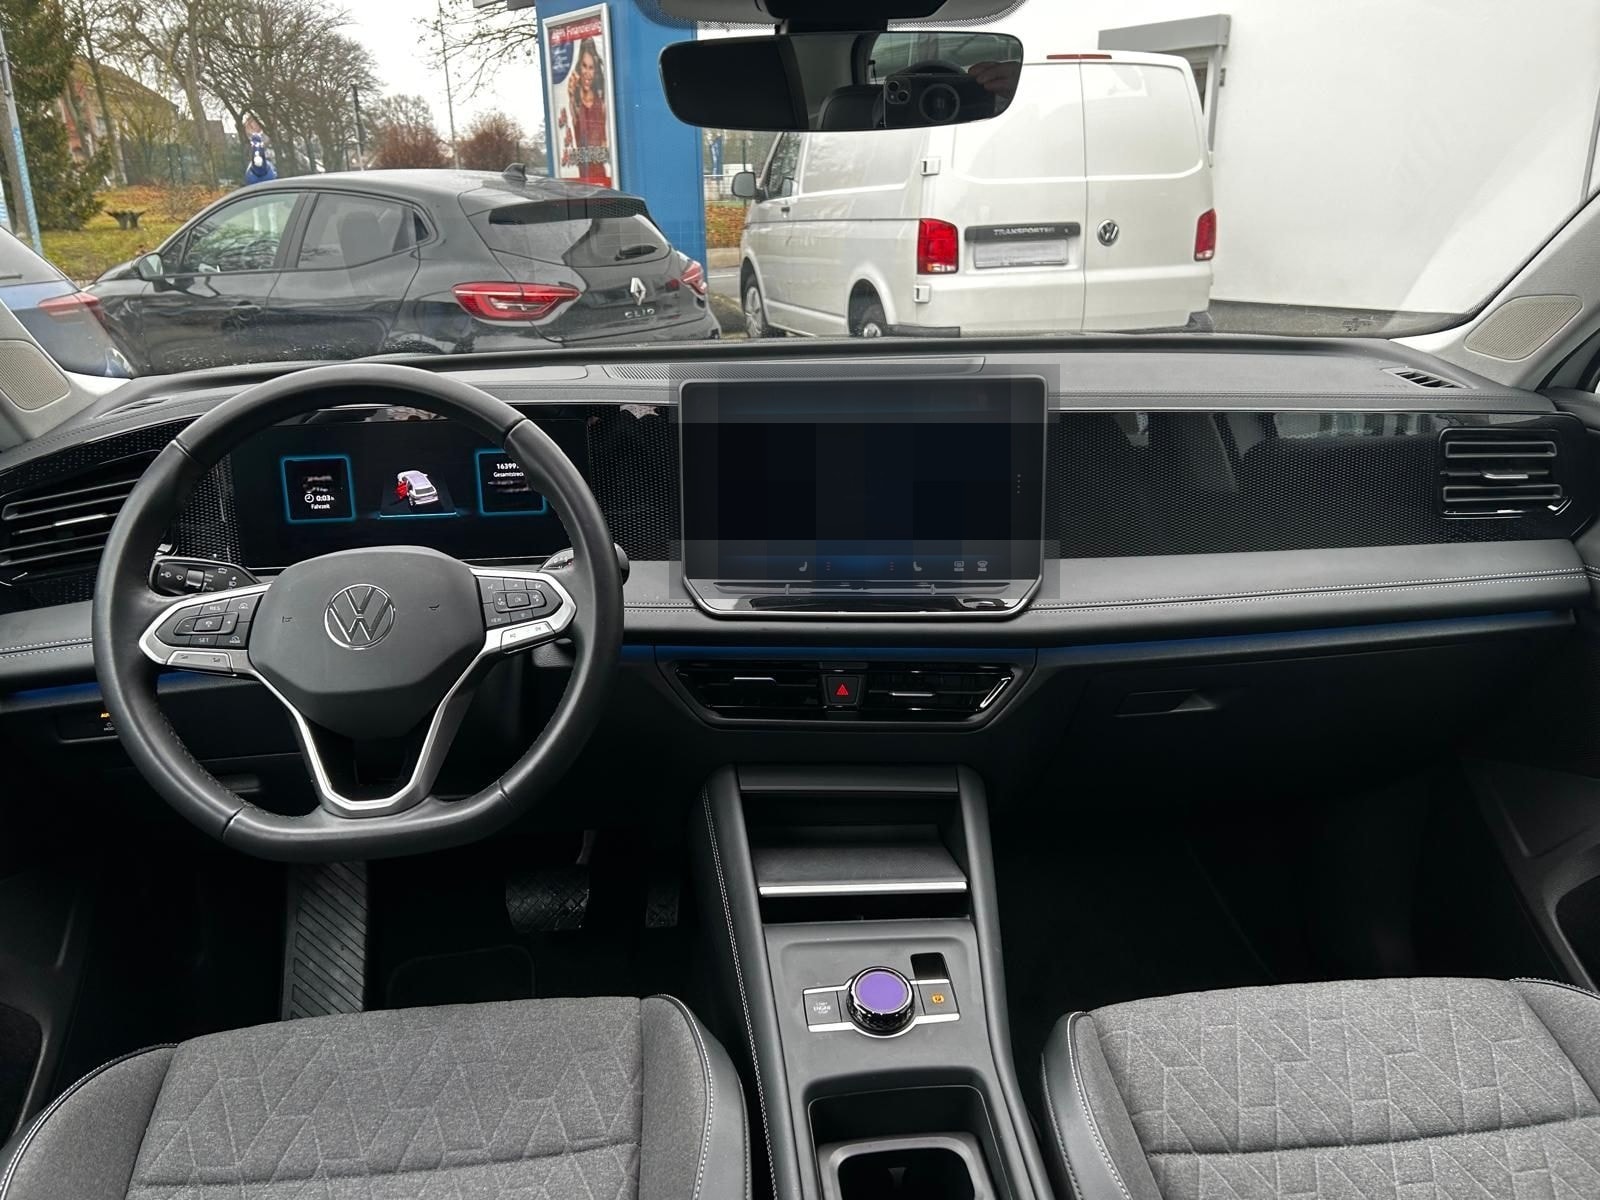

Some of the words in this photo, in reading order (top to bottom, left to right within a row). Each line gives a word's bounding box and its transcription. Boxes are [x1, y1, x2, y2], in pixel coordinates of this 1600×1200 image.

[993, 226, 1055, 236] TRANSPORTER
[624, 308, 655, 318] CLIO
[496, 462, 517, 470] 16399
[315, 494, 331, 502] 0:03
